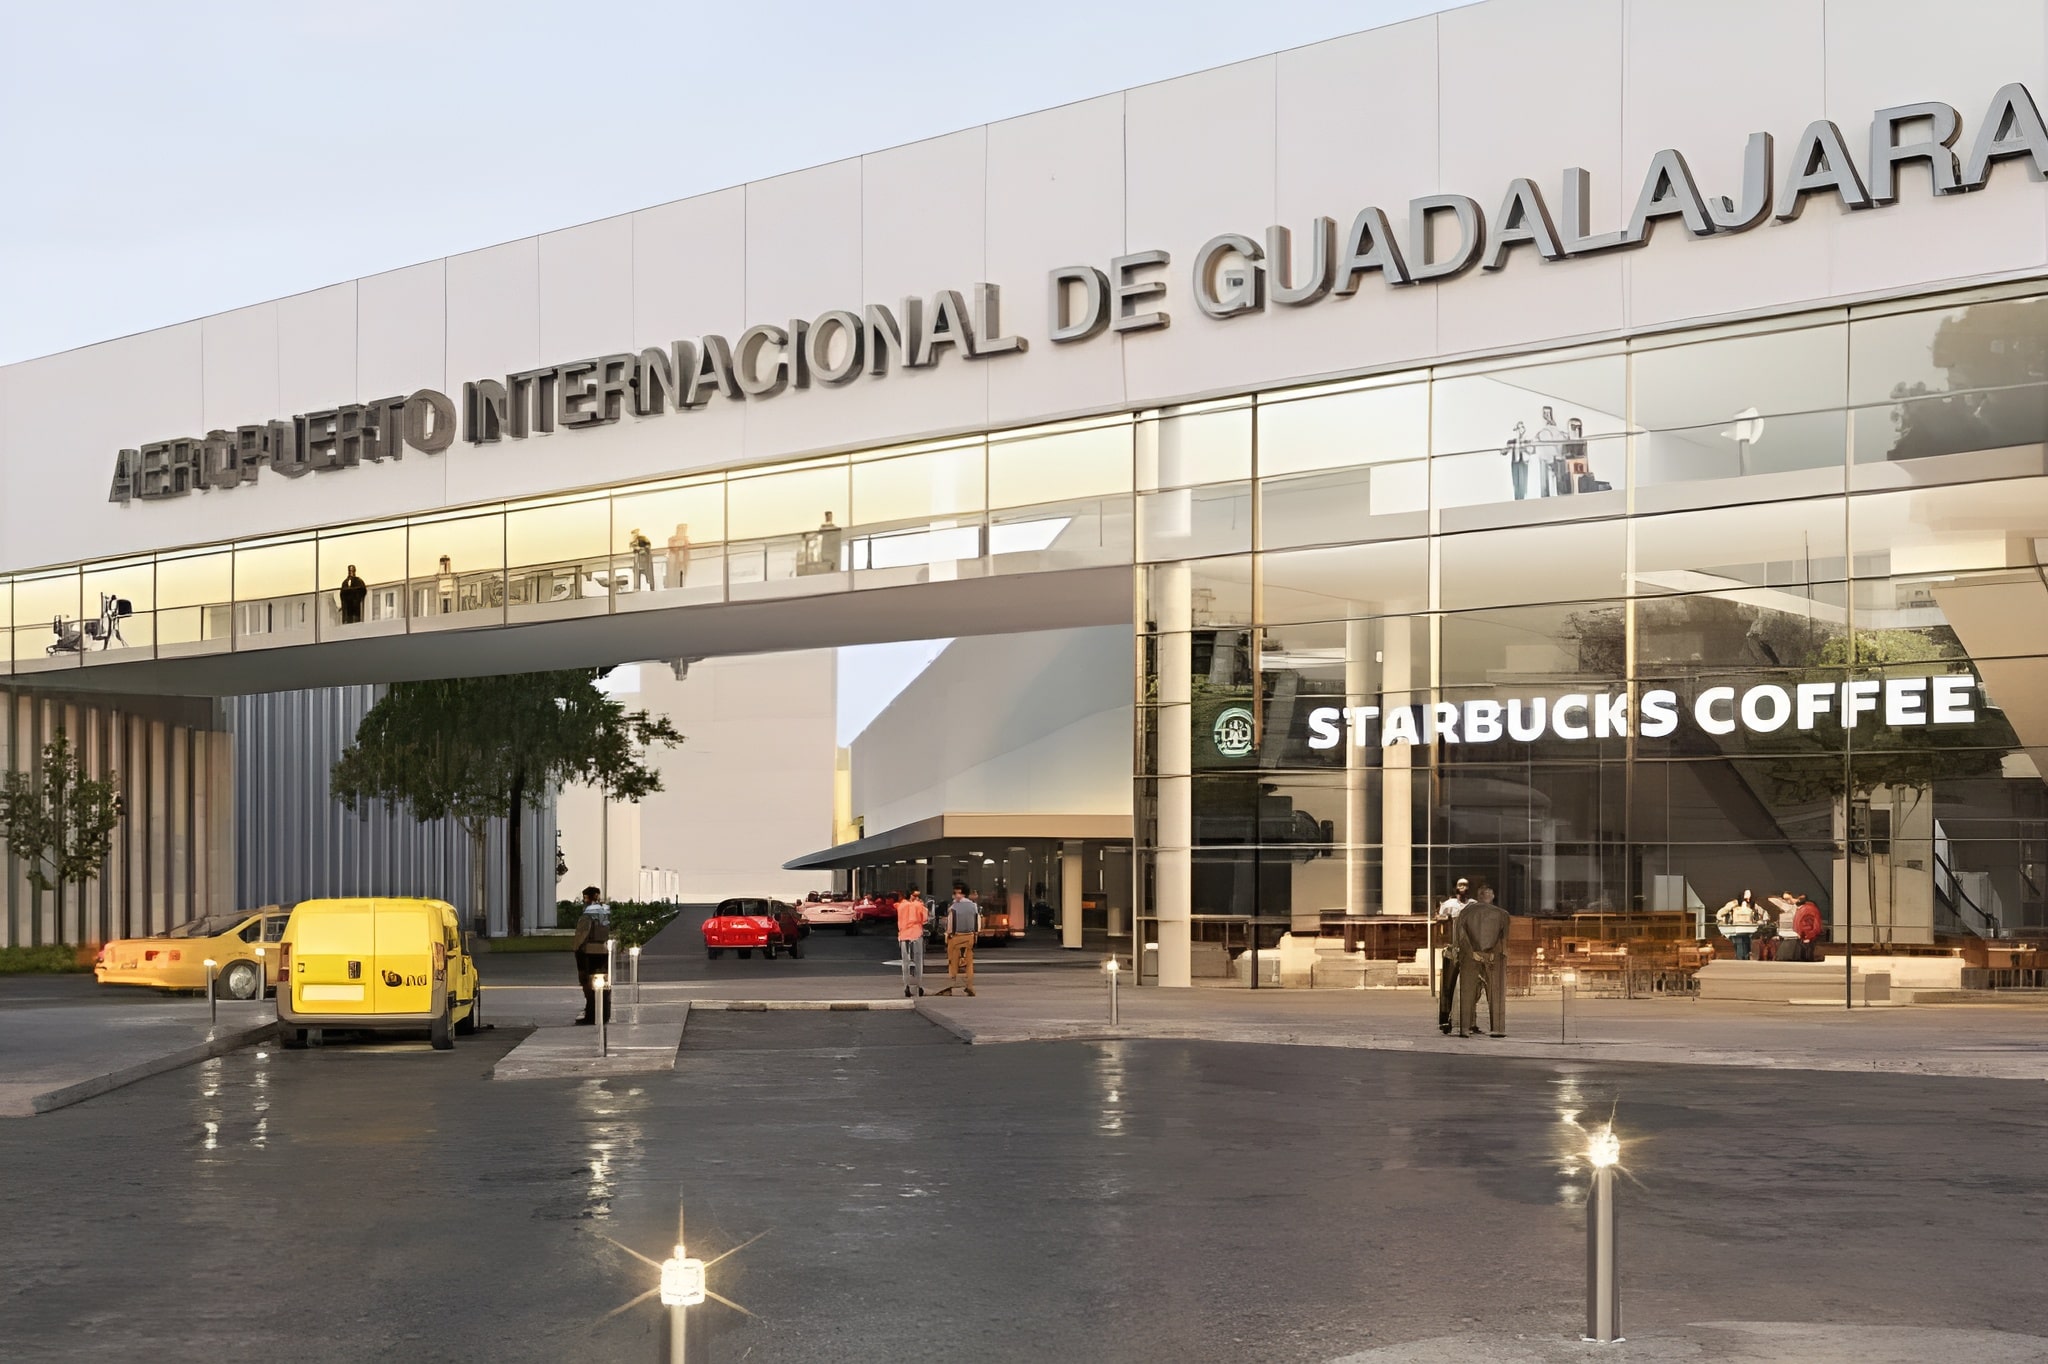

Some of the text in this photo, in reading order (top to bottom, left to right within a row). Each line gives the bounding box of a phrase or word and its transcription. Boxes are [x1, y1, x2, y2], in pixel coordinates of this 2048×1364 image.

[109, 81, 2048, 501] AEROPUERTO INTERNACIONAL DE GUADALAJARA
[1307, 688, 1679, 750] STARBUCKS
[1693, 674, 1977, 735] COFFEE
